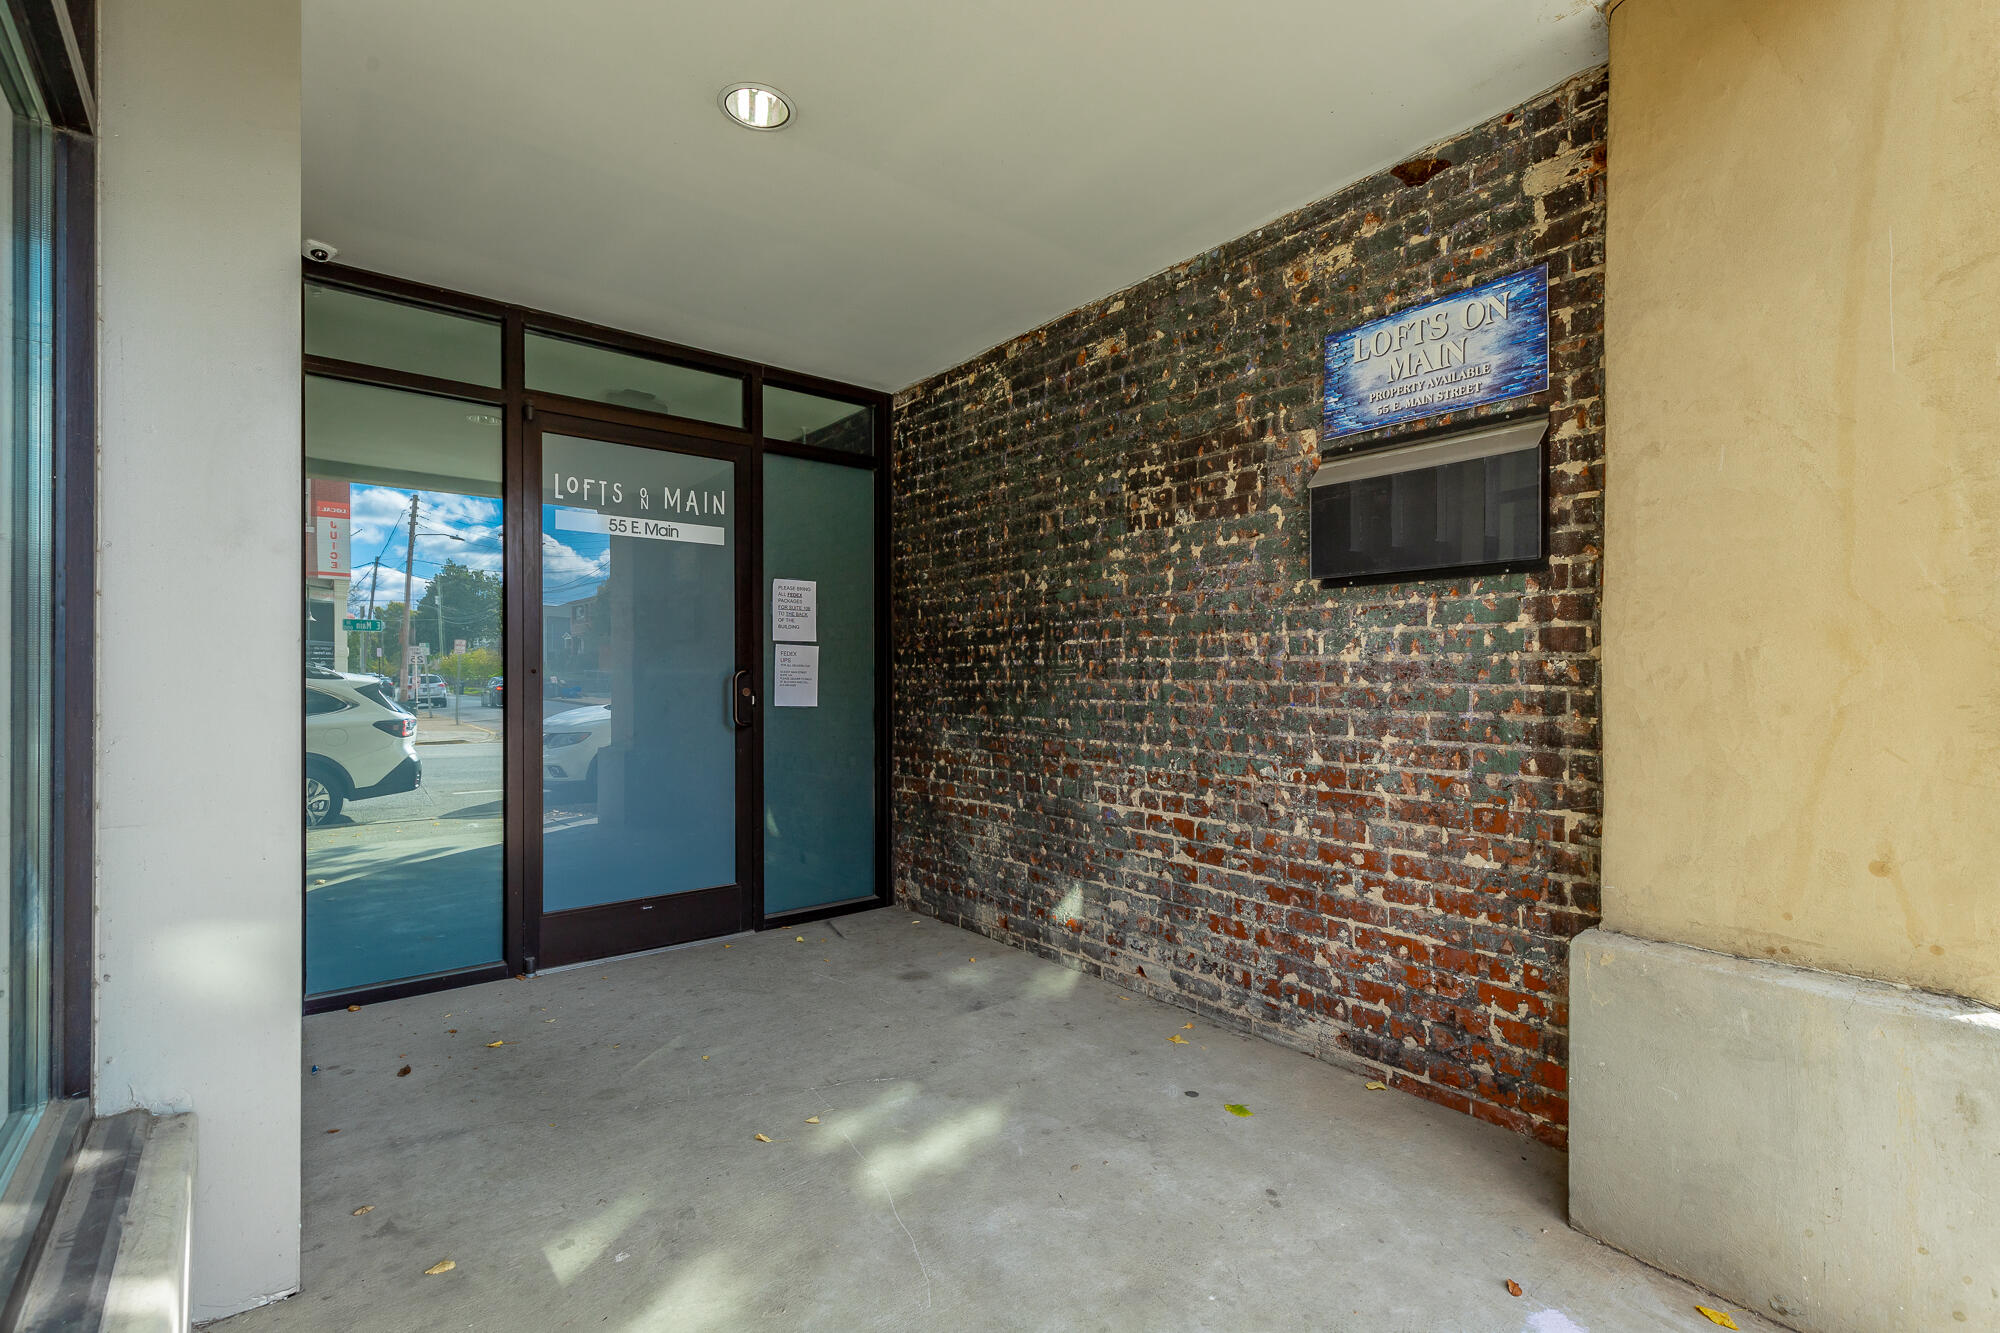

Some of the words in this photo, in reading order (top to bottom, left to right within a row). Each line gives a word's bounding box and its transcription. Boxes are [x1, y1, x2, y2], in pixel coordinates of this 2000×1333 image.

[1352, 311, 1449, 364] LOFTS
[1460, 291, 1511, 331] ON
[1387, 336, 1468, 384] MAIN
[1369, 380, 1425, 403] PROPERTY
[1427, 363, 1492, 387] AVAILABLE
[1376, 405, 1390, 416] 55
[1394, 401, 1403, 412] E.
[1405, 395, 1434, 410] MAIN
[1437, 382, 1482, 402] STREET
[554, 472, 624, 506] LOFTS
[664, 486, 725, 516] MAIN
[608, 518, 627, 533] 55
[631, 521, 641, 534] E.
[645, 522, 679, 538] Main
